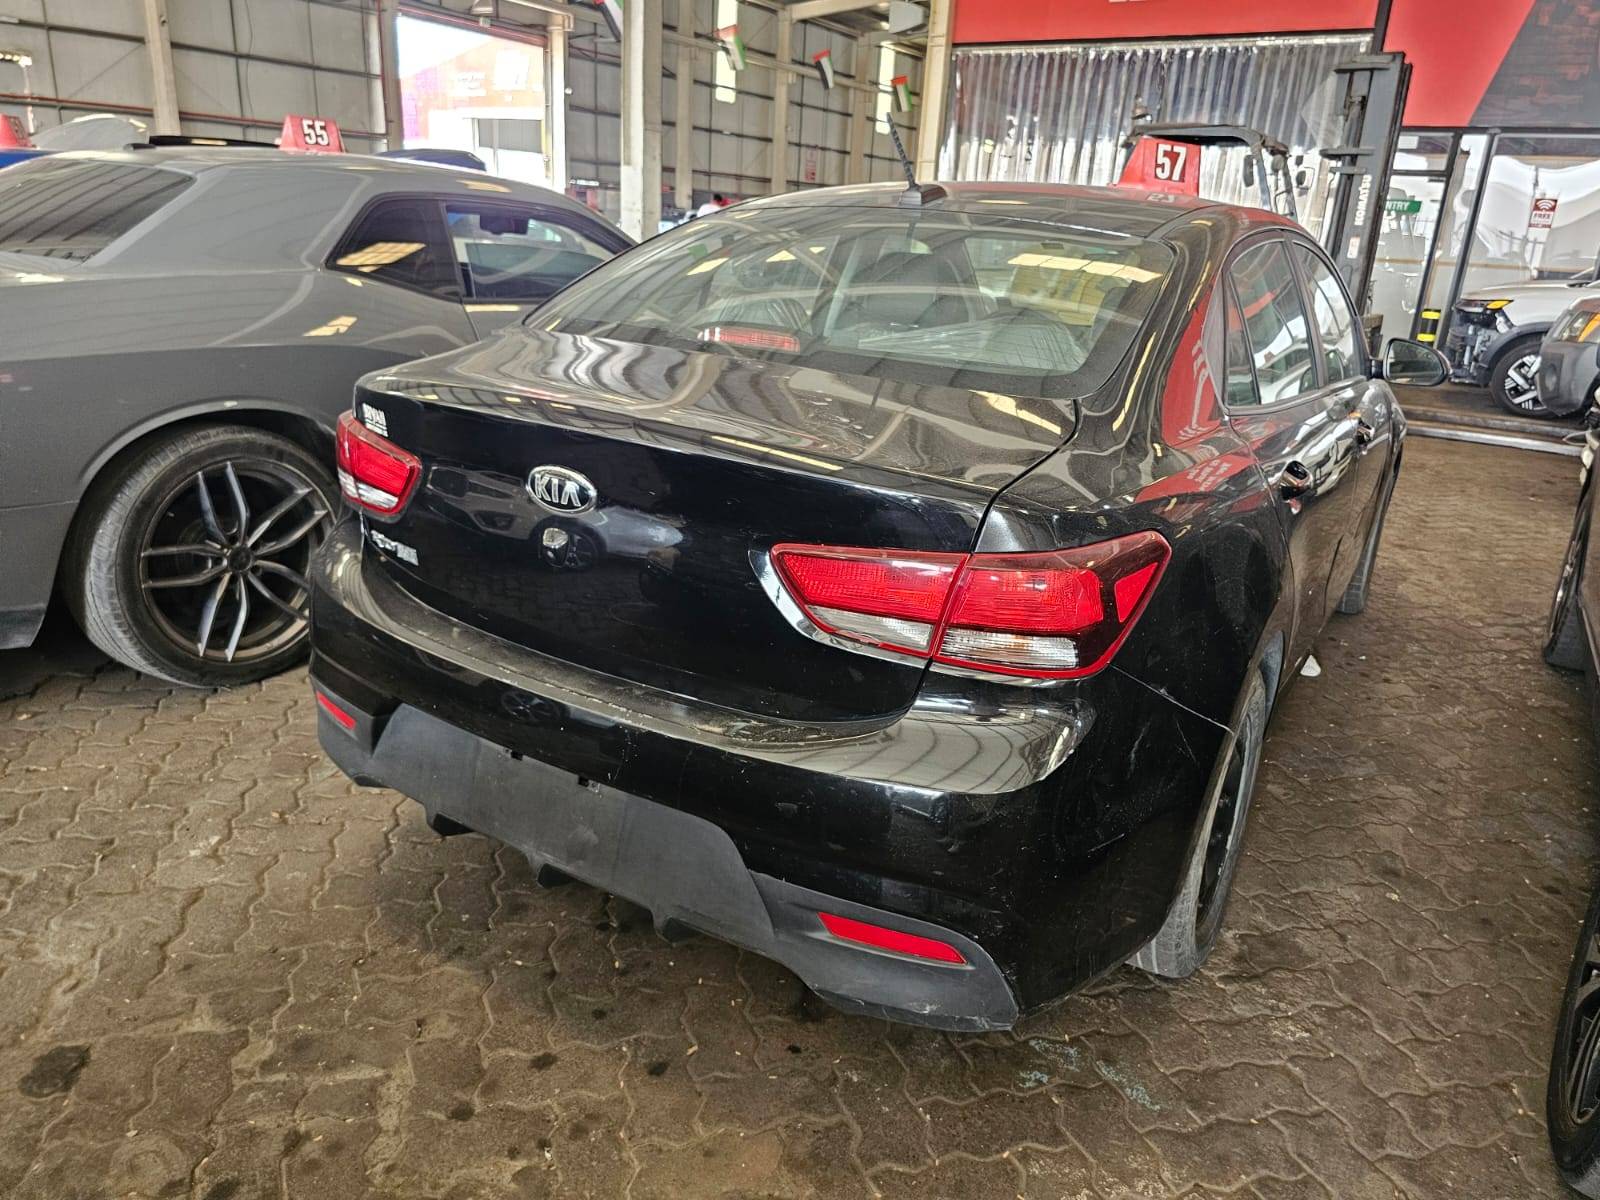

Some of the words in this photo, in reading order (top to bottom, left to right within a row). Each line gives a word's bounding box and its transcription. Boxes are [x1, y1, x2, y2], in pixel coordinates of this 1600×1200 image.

[302, 119, 330, 146] 55
[1155, 143, 1187, 181] 57
[1354, 174, 1373, 226] KOMATSU
[1385, 200, 1409, 211] NTRY
[1533, 212, 1551, 220] FREE
[534, 473, 582, 507] KIA
